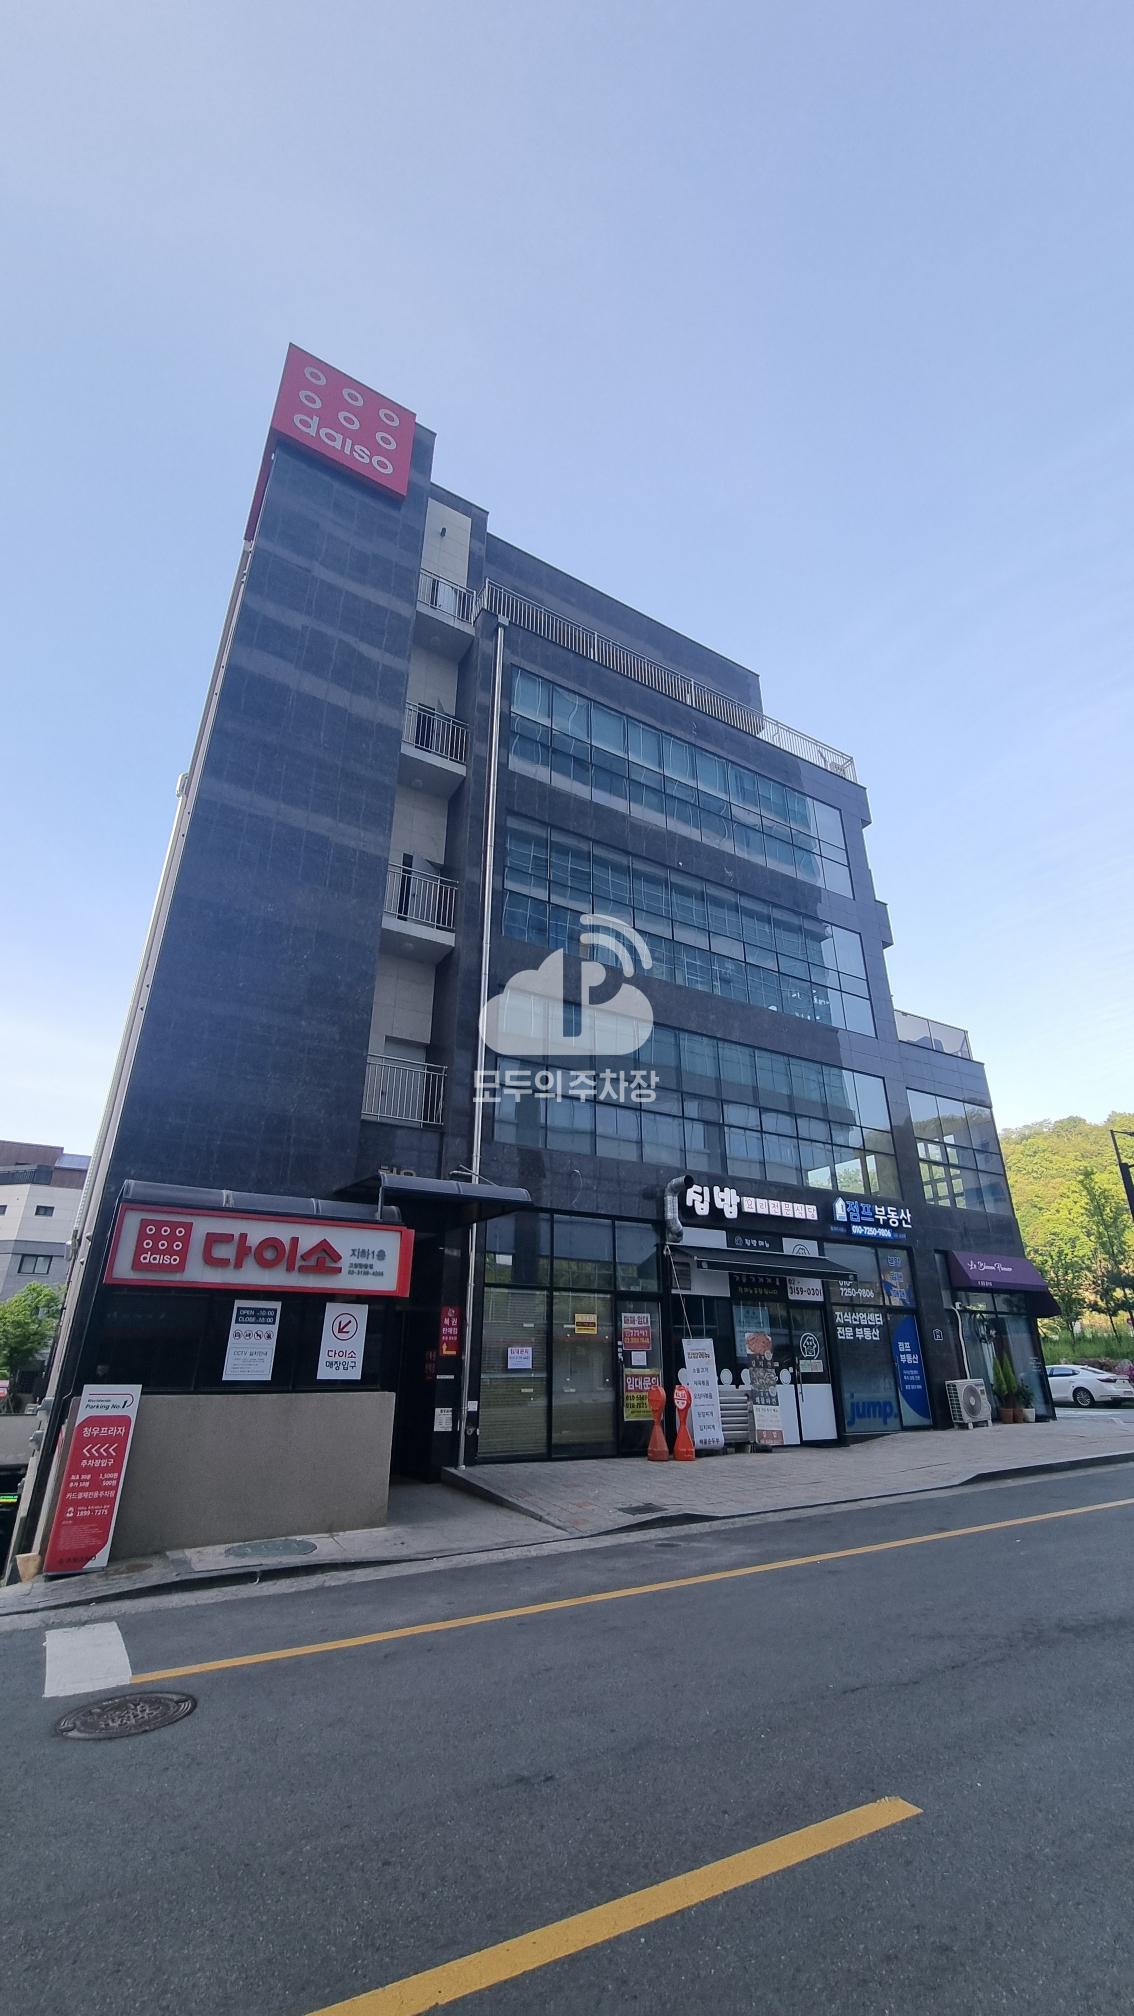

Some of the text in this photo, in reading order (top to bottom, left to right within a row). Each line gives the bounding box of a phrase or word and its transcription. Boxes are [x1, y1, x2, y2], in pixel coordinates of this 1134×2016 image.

[293, 413, 394, 474] daiso
[686, 1184, 816, 1219] 집밥 요리전문식당
[851, 1225, 892, 1237] 010-7250-9806
[140, 1251, 180, 1265] daiso
[202, 1231, 343, 1274] 다이소
[789, 1286, 822, 1297] 3159-0301
[840, 1288, 874, 1298] 7250-9806
[835, 1311, 883, 1325] 지식산업센터
[837, 1327, 880, 1340] 전문 부동산
[898, 1341, 911, 1352] 점프
[327, 1349, 357, 1358] 다이소
[900, 1353, 919, 1364] 부동산
[325, 1361, 357, 1371] 매장입구
[82, 1426, 125, 1437] 청우프라자
[80, 1459, 114, 1468] 주차장입구
